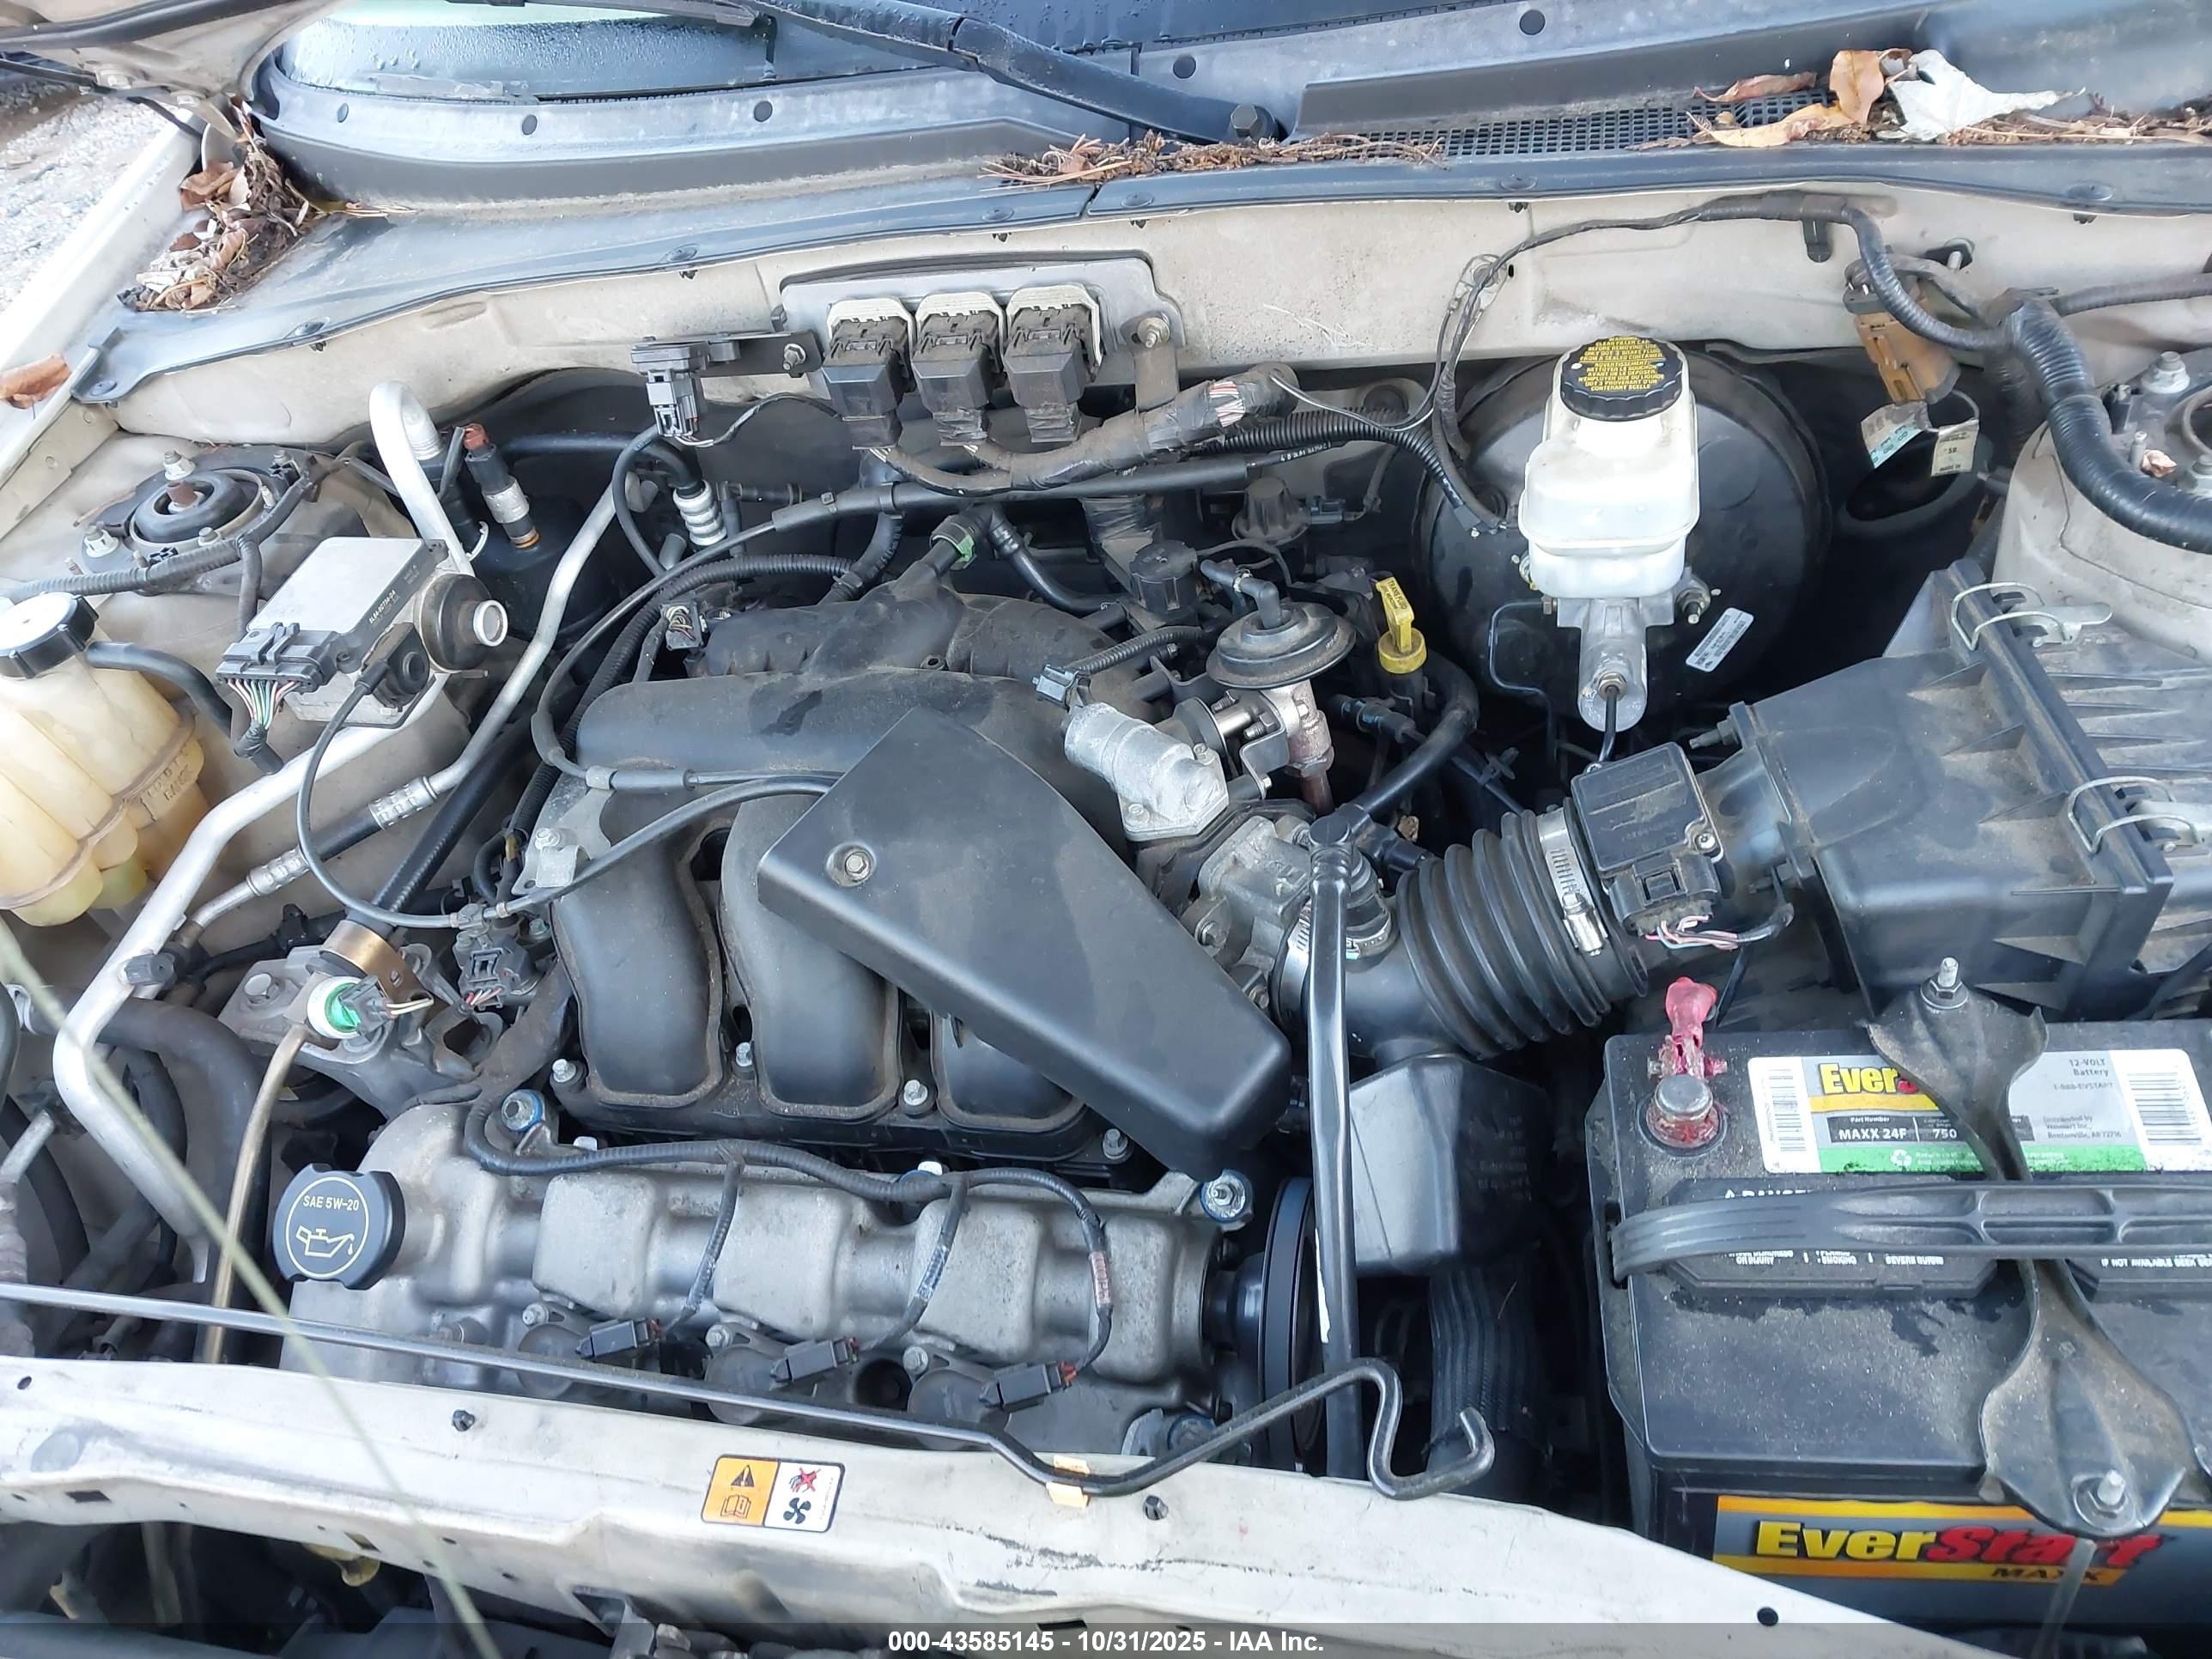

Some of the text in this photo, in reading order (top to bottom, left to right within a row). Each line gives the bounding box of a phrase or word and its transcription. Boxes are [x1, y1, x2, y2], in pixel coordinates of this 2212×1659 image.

[2069, 1057, 2106, 1066] 12-VOLT
[2073, 1068, 2109, 1077] Battery
[1838, 1127, 1907, 1140] MAXX 24F
[1932, 1128, 1957, 1139] 750
[303, 1194, 360, 1211] SAE 5W-20
[1748, 1256, 1774, 1266] INJURY
[2111, 1258, 2128, 1267] NOT
[2130, 1258, 2172, 1267] AVAILABLE
